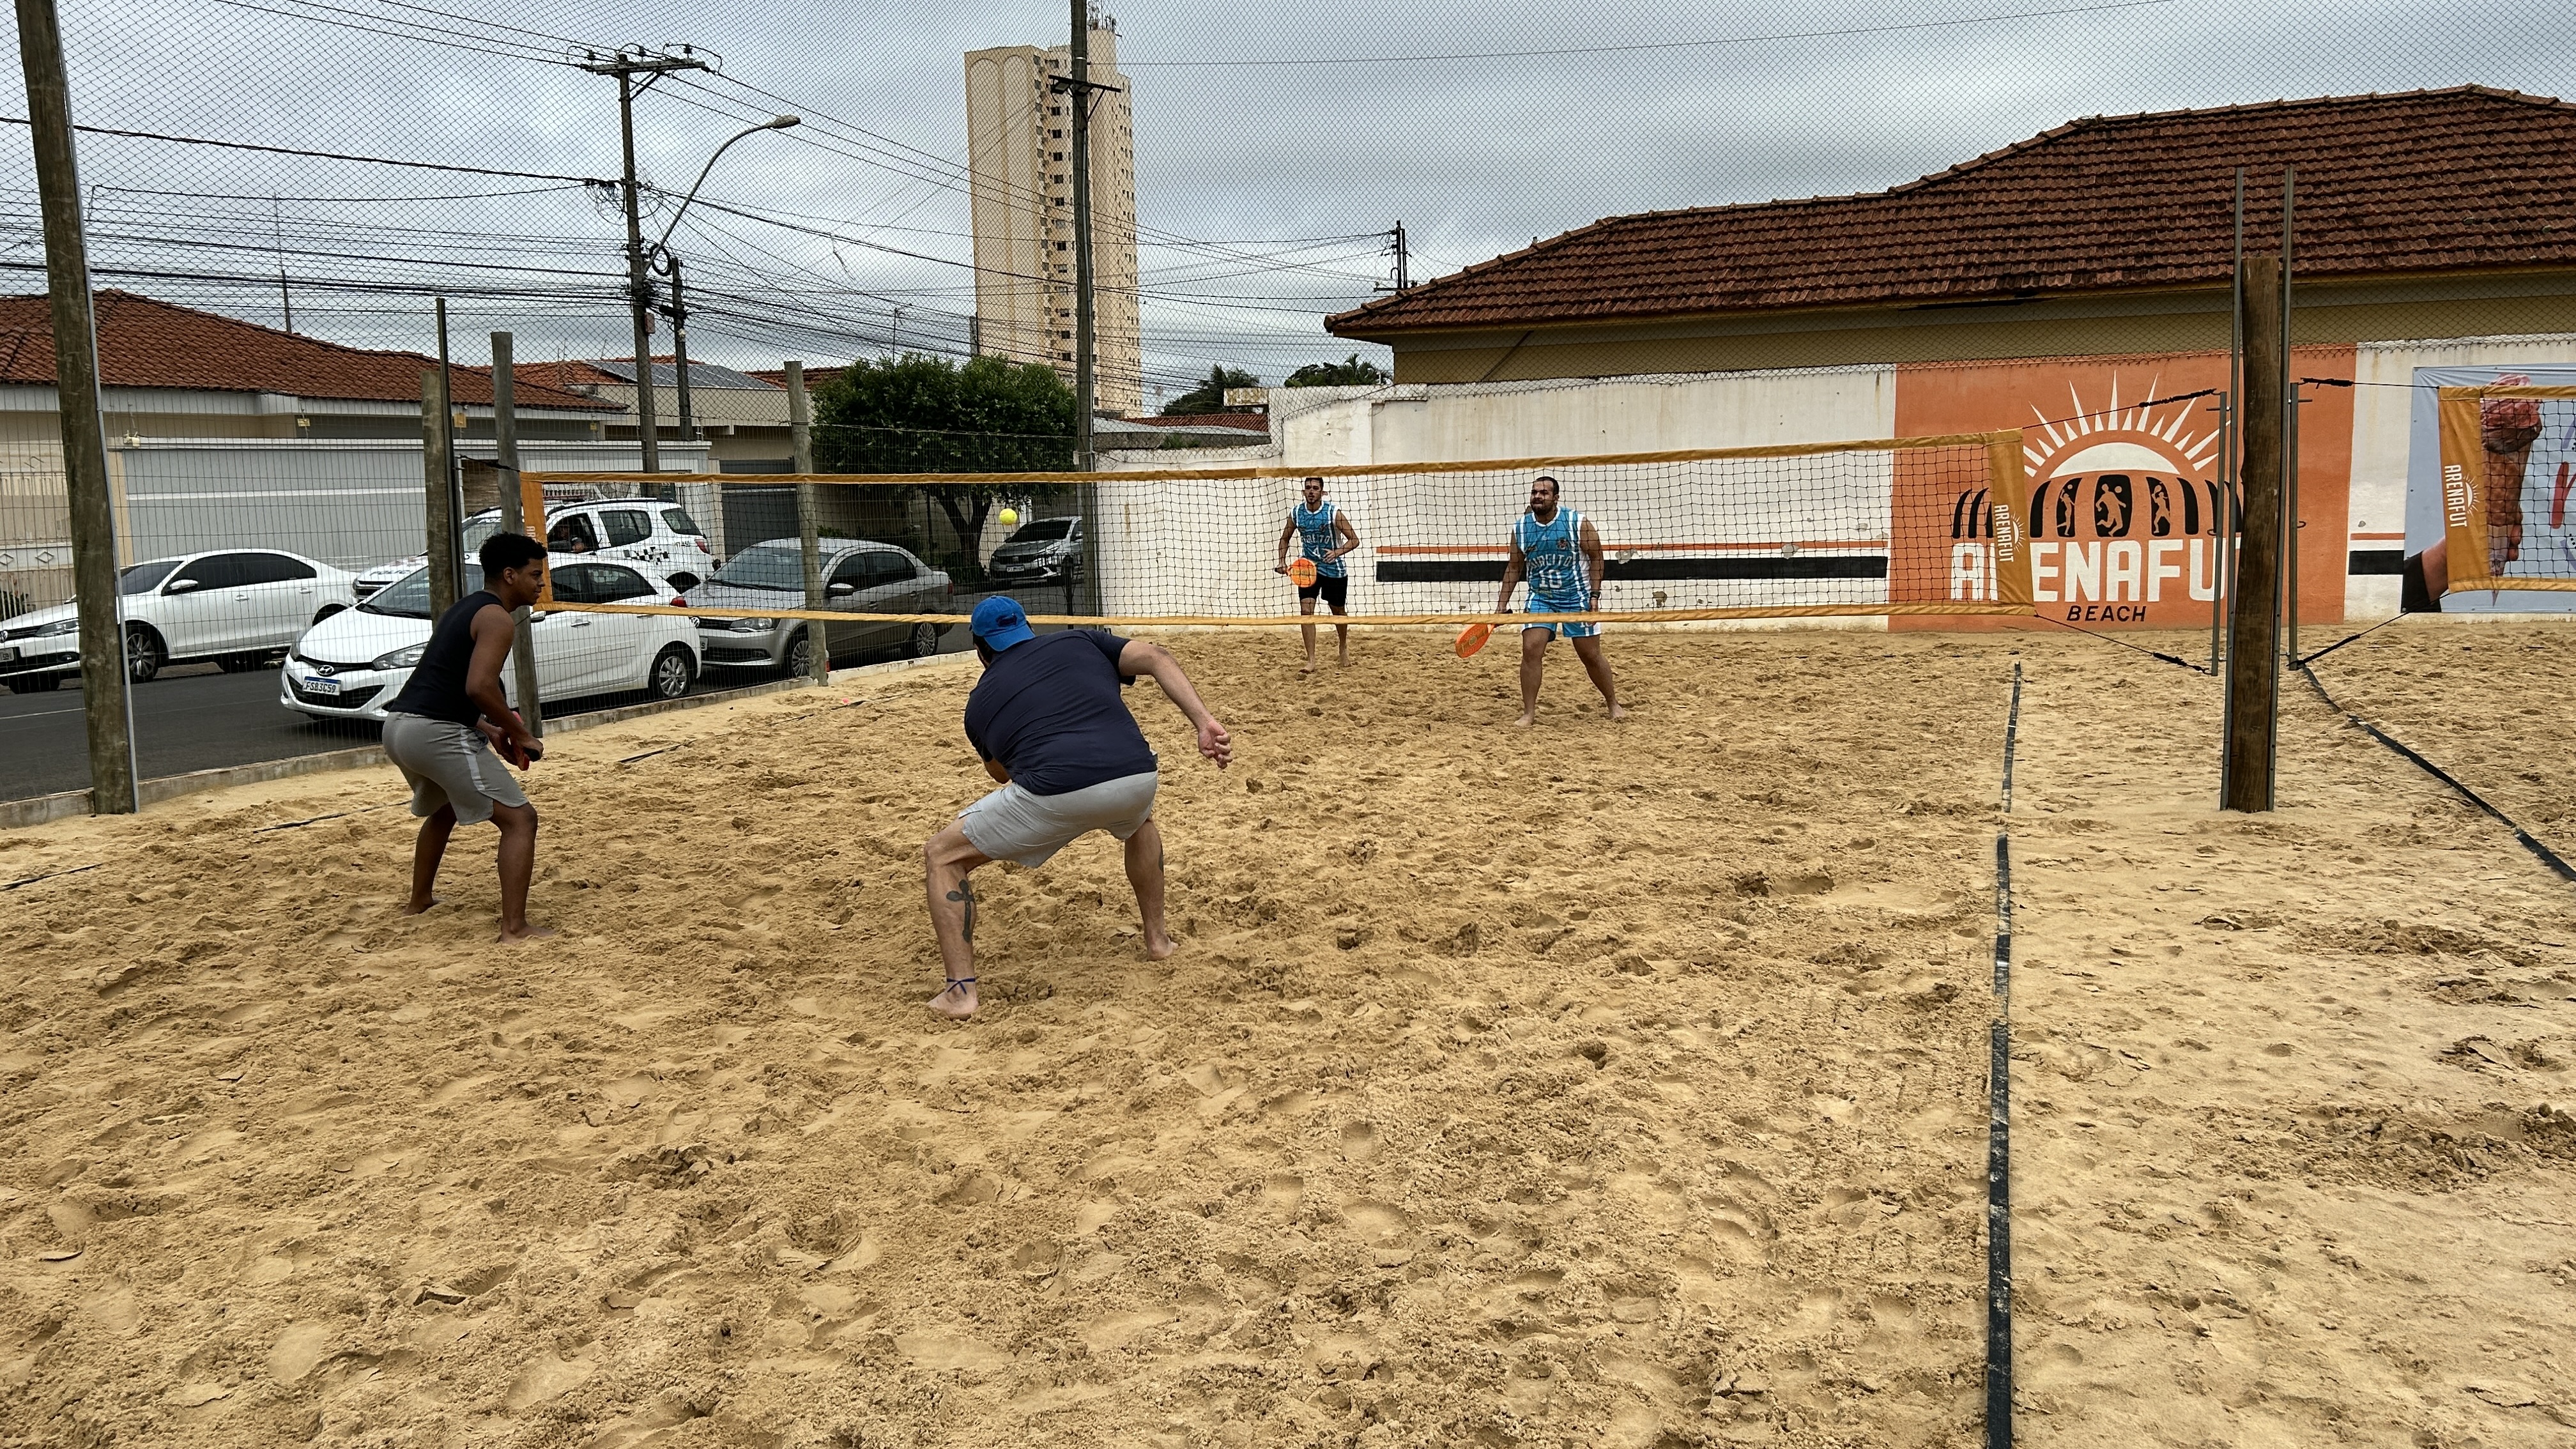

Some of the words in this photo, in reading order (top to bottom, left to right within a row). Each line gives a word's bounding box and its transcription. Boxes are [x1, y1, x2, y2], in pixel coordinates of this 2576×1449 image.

[2444, 464, 2467, 527] ARENAFUT
[1994, 504, 2014, 562] ARENAFUT
[1539, 569, 1563, 588] 10
[1951, 537, 2241, 602] AENAFU
[2066, 605, 2147, 622] BEACH
[305, 681, 336, 694] FSB3C59
